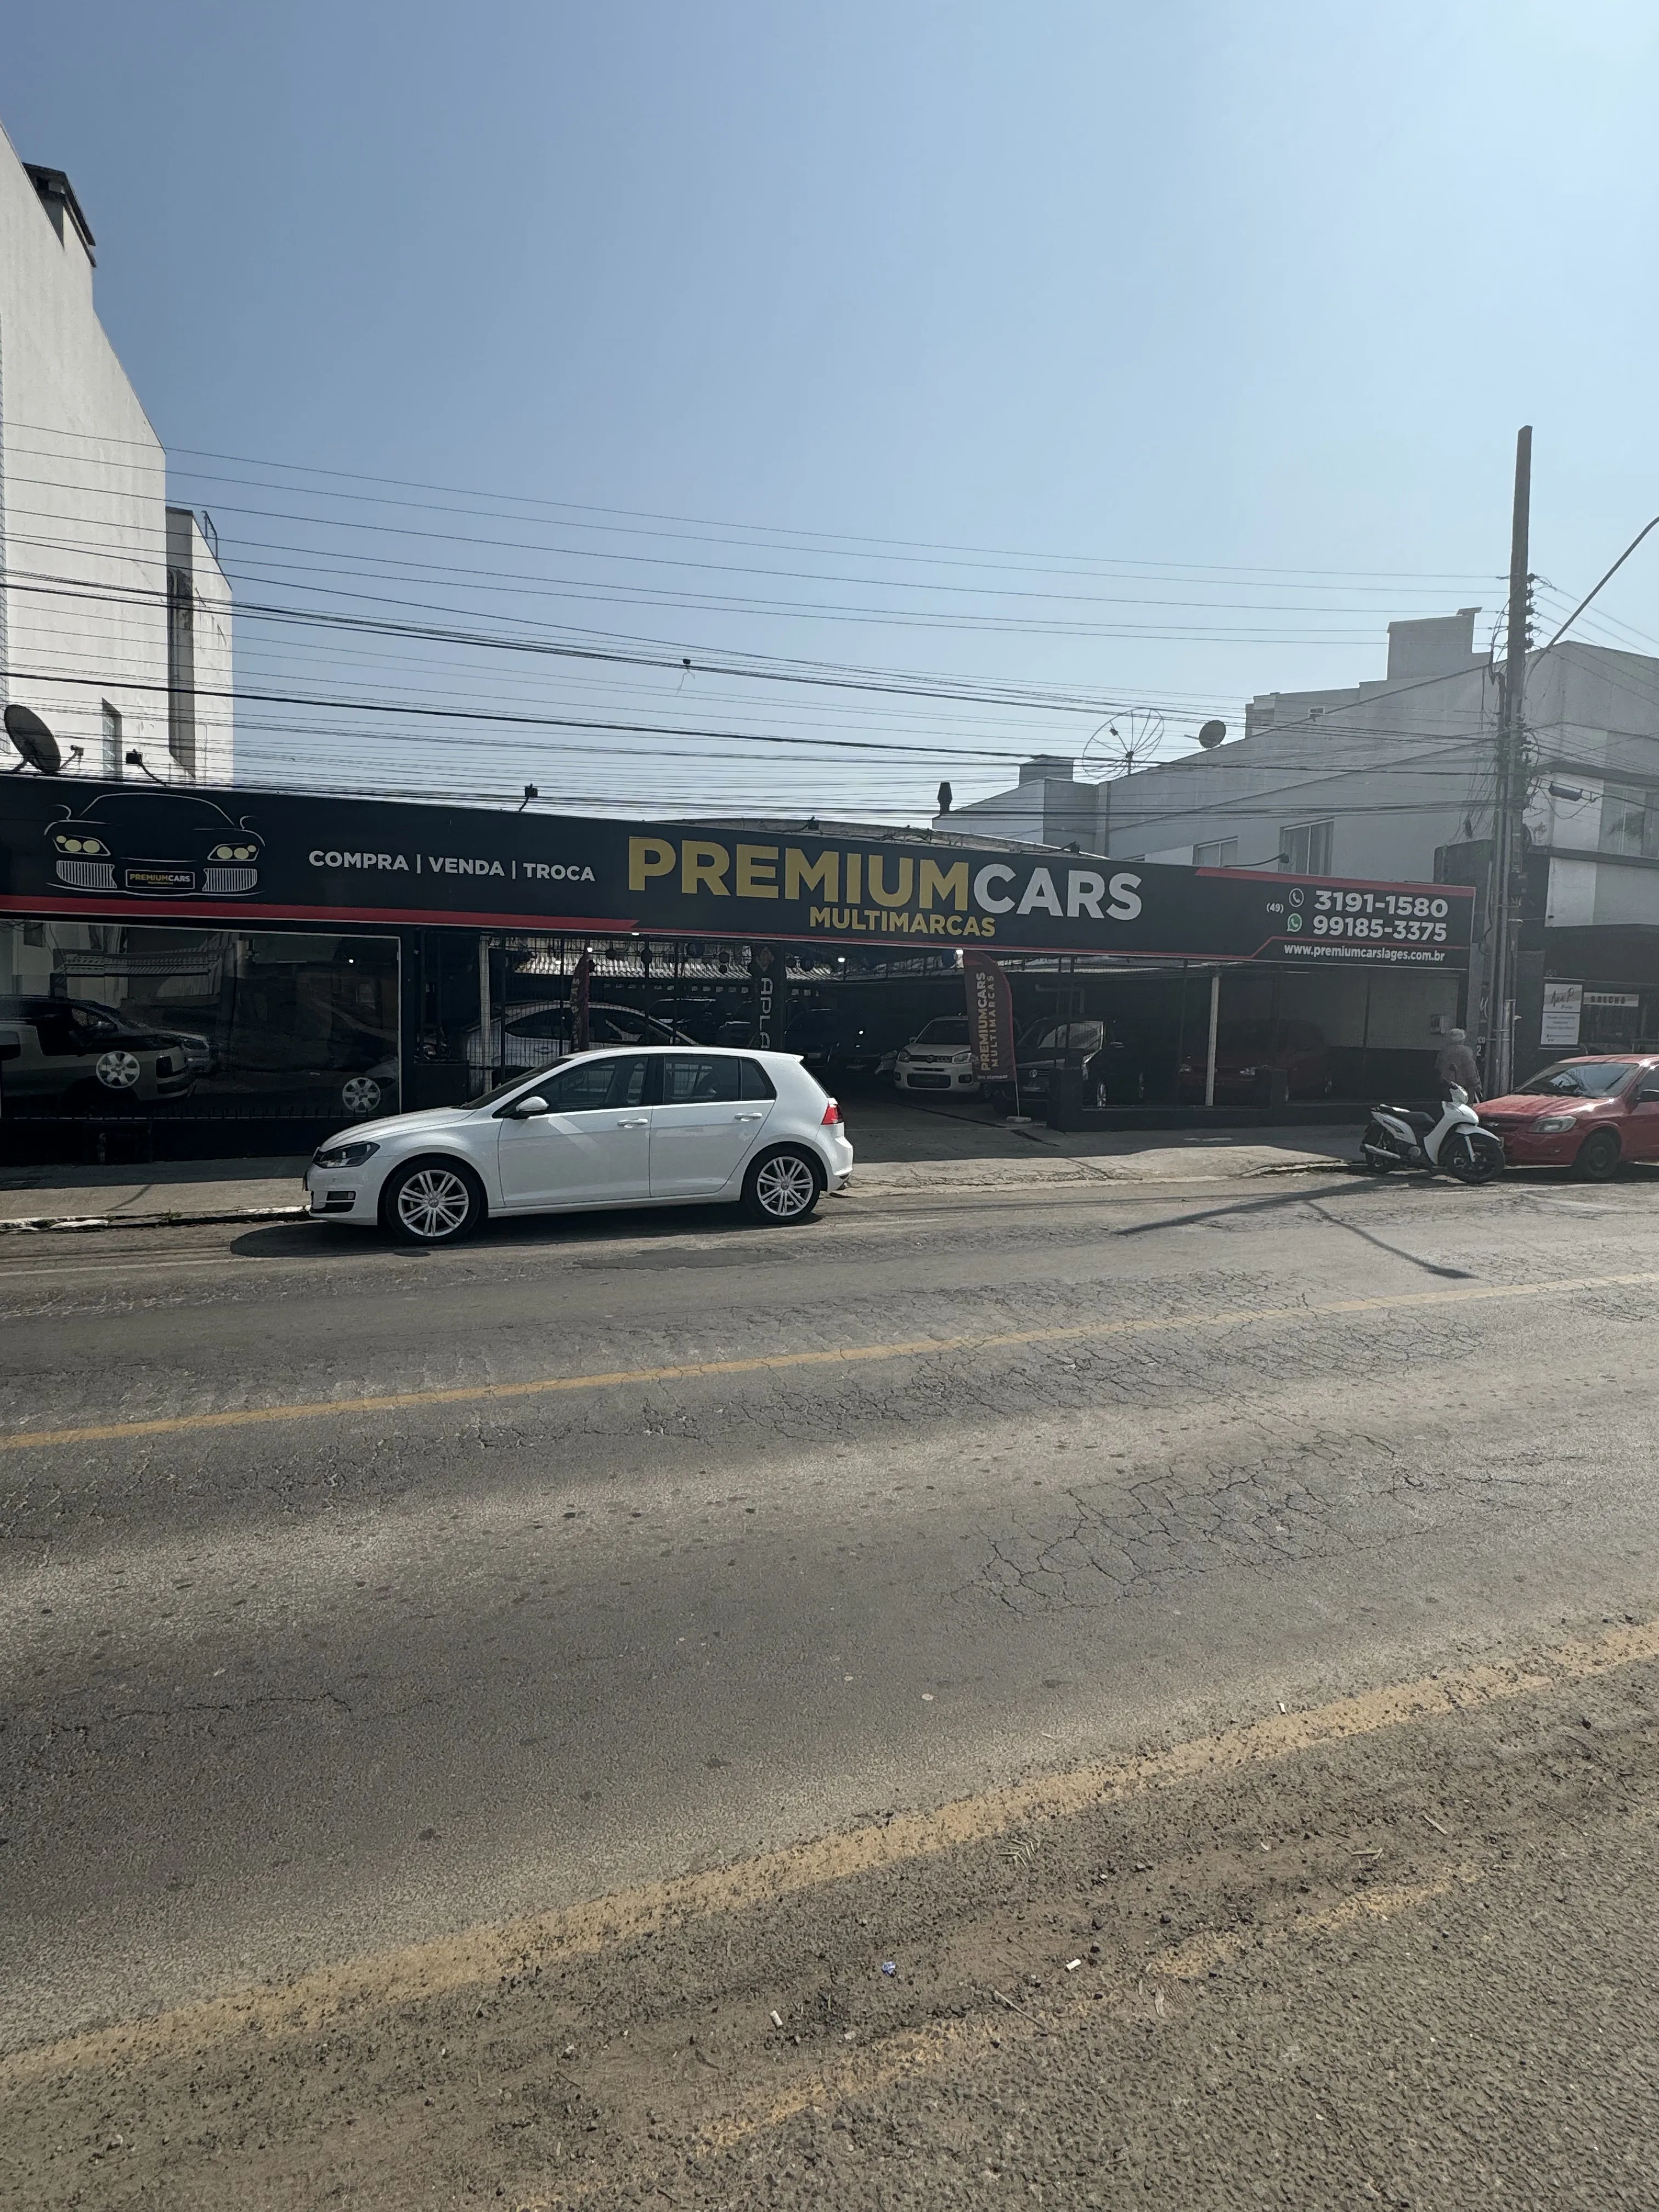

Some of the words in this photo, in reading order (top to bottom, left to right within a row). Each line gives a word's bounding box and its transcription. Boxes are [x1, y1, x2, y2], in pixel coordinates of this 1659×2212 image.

[129, 873, 191, 882] PREMIUMCARS
[308, 850, 410, 871] COMPRA
[428, 856, 505, 877] VENDA
[522, 862, 596, 882] TROCA
[628, 836, 1143, 921] PREMIUMCARS
[1266, 902, 1284, 913] (49)
[1314, 890, 1448, 918] 3191-1580
[809, 906, 996, 937] MULTIMARCAS
[1313, 915, 1447, 941] 99185-3375
[1284, 944, 1446, 961] www.premiumcarslages.com.br
[976, 972, 991, 1071] PREMIUMCARS
[987, 975, 1000, 1067] MULTIMARCAS
